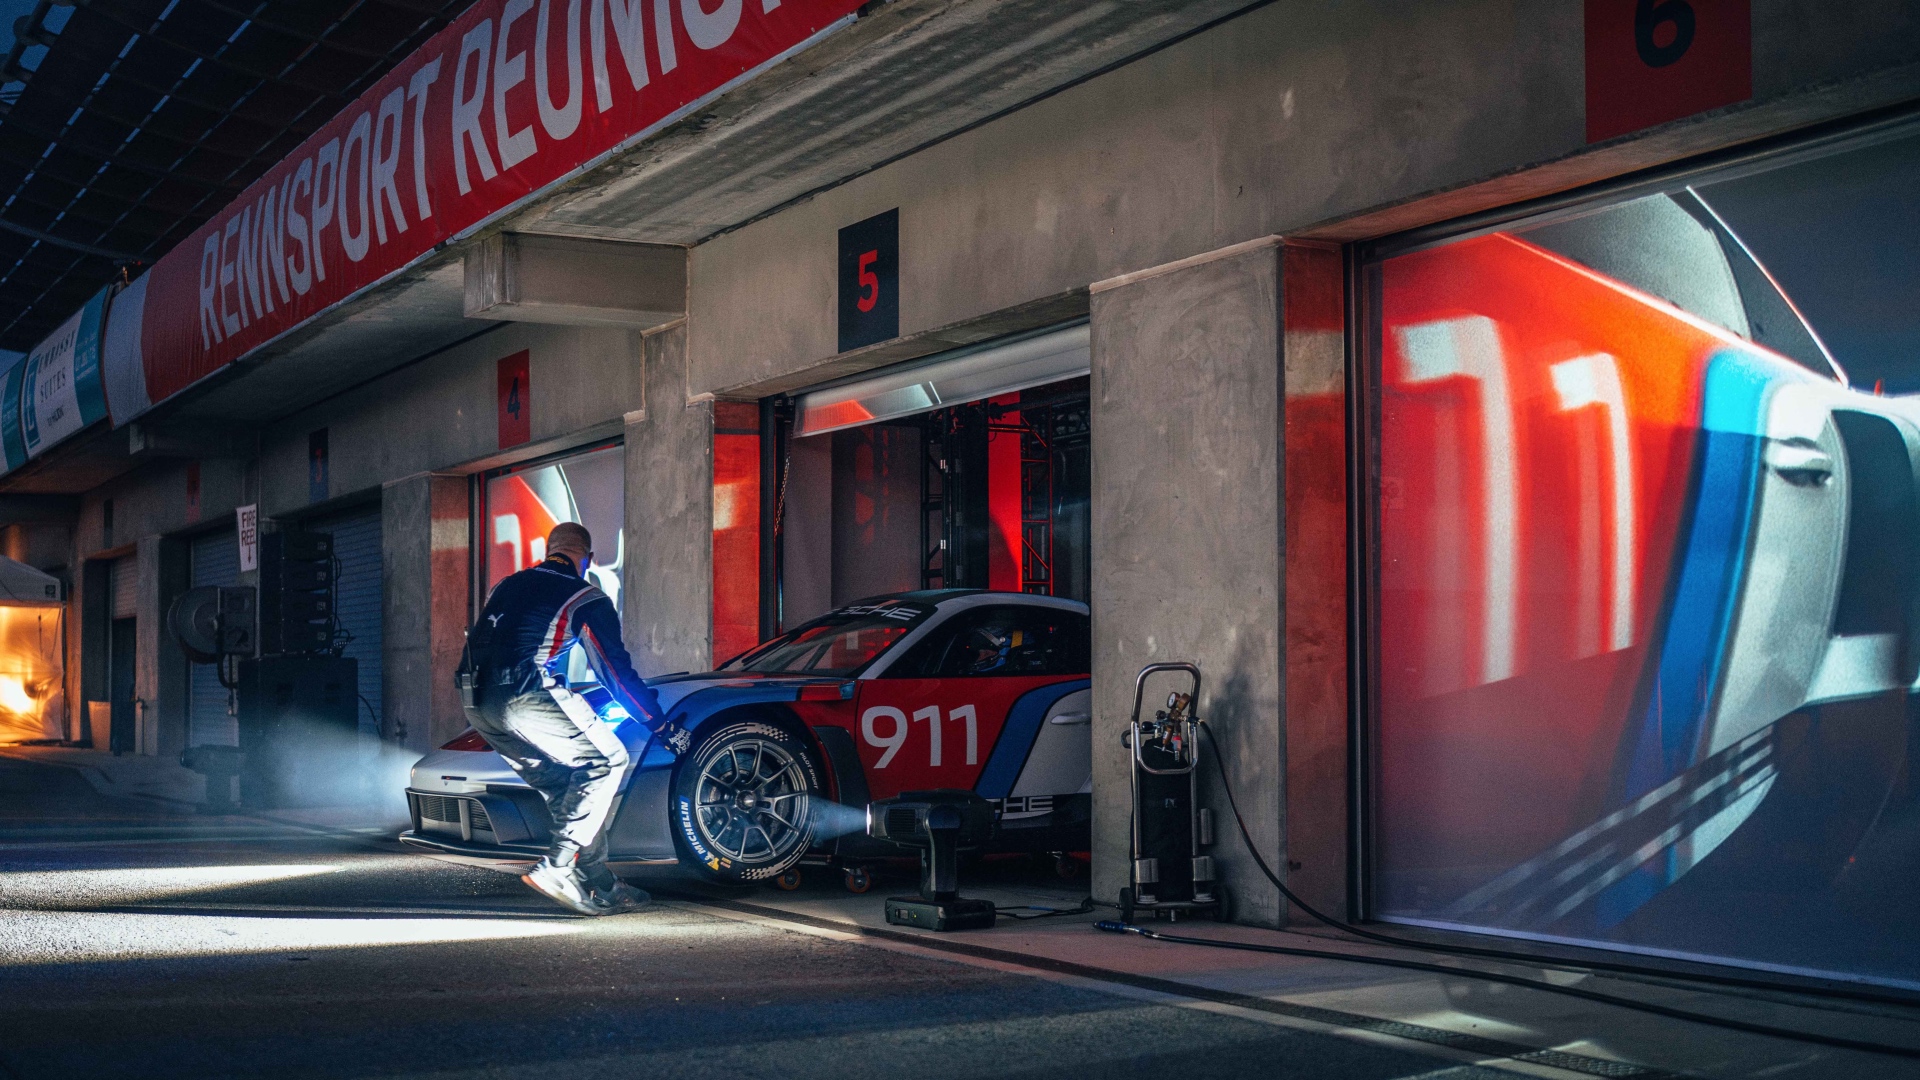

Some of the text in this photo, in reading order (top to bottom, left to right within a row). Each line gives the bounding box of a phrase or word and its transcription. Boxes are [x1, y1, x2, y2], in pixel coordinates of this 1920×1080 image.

[1634, 0, 1696, 67] 6
[199, 0, 781, 350] RENNSPORT REUN
[857, 249, 879, 312] 5
[39, 366, 67, 403] SUITES
[506, 377, 520, 420] 4
[241, 510, 255, 528] FIRE
[241, 528, 256, 546] REEL
[827, 604, 922, 621] SCHE
[861, 704, 978, 769] 911
[800, 752, 819, 789] PILOT SPORT
[986, 796, 1053, 813] HE
[680, 801, 706, 856] MICHELIN
